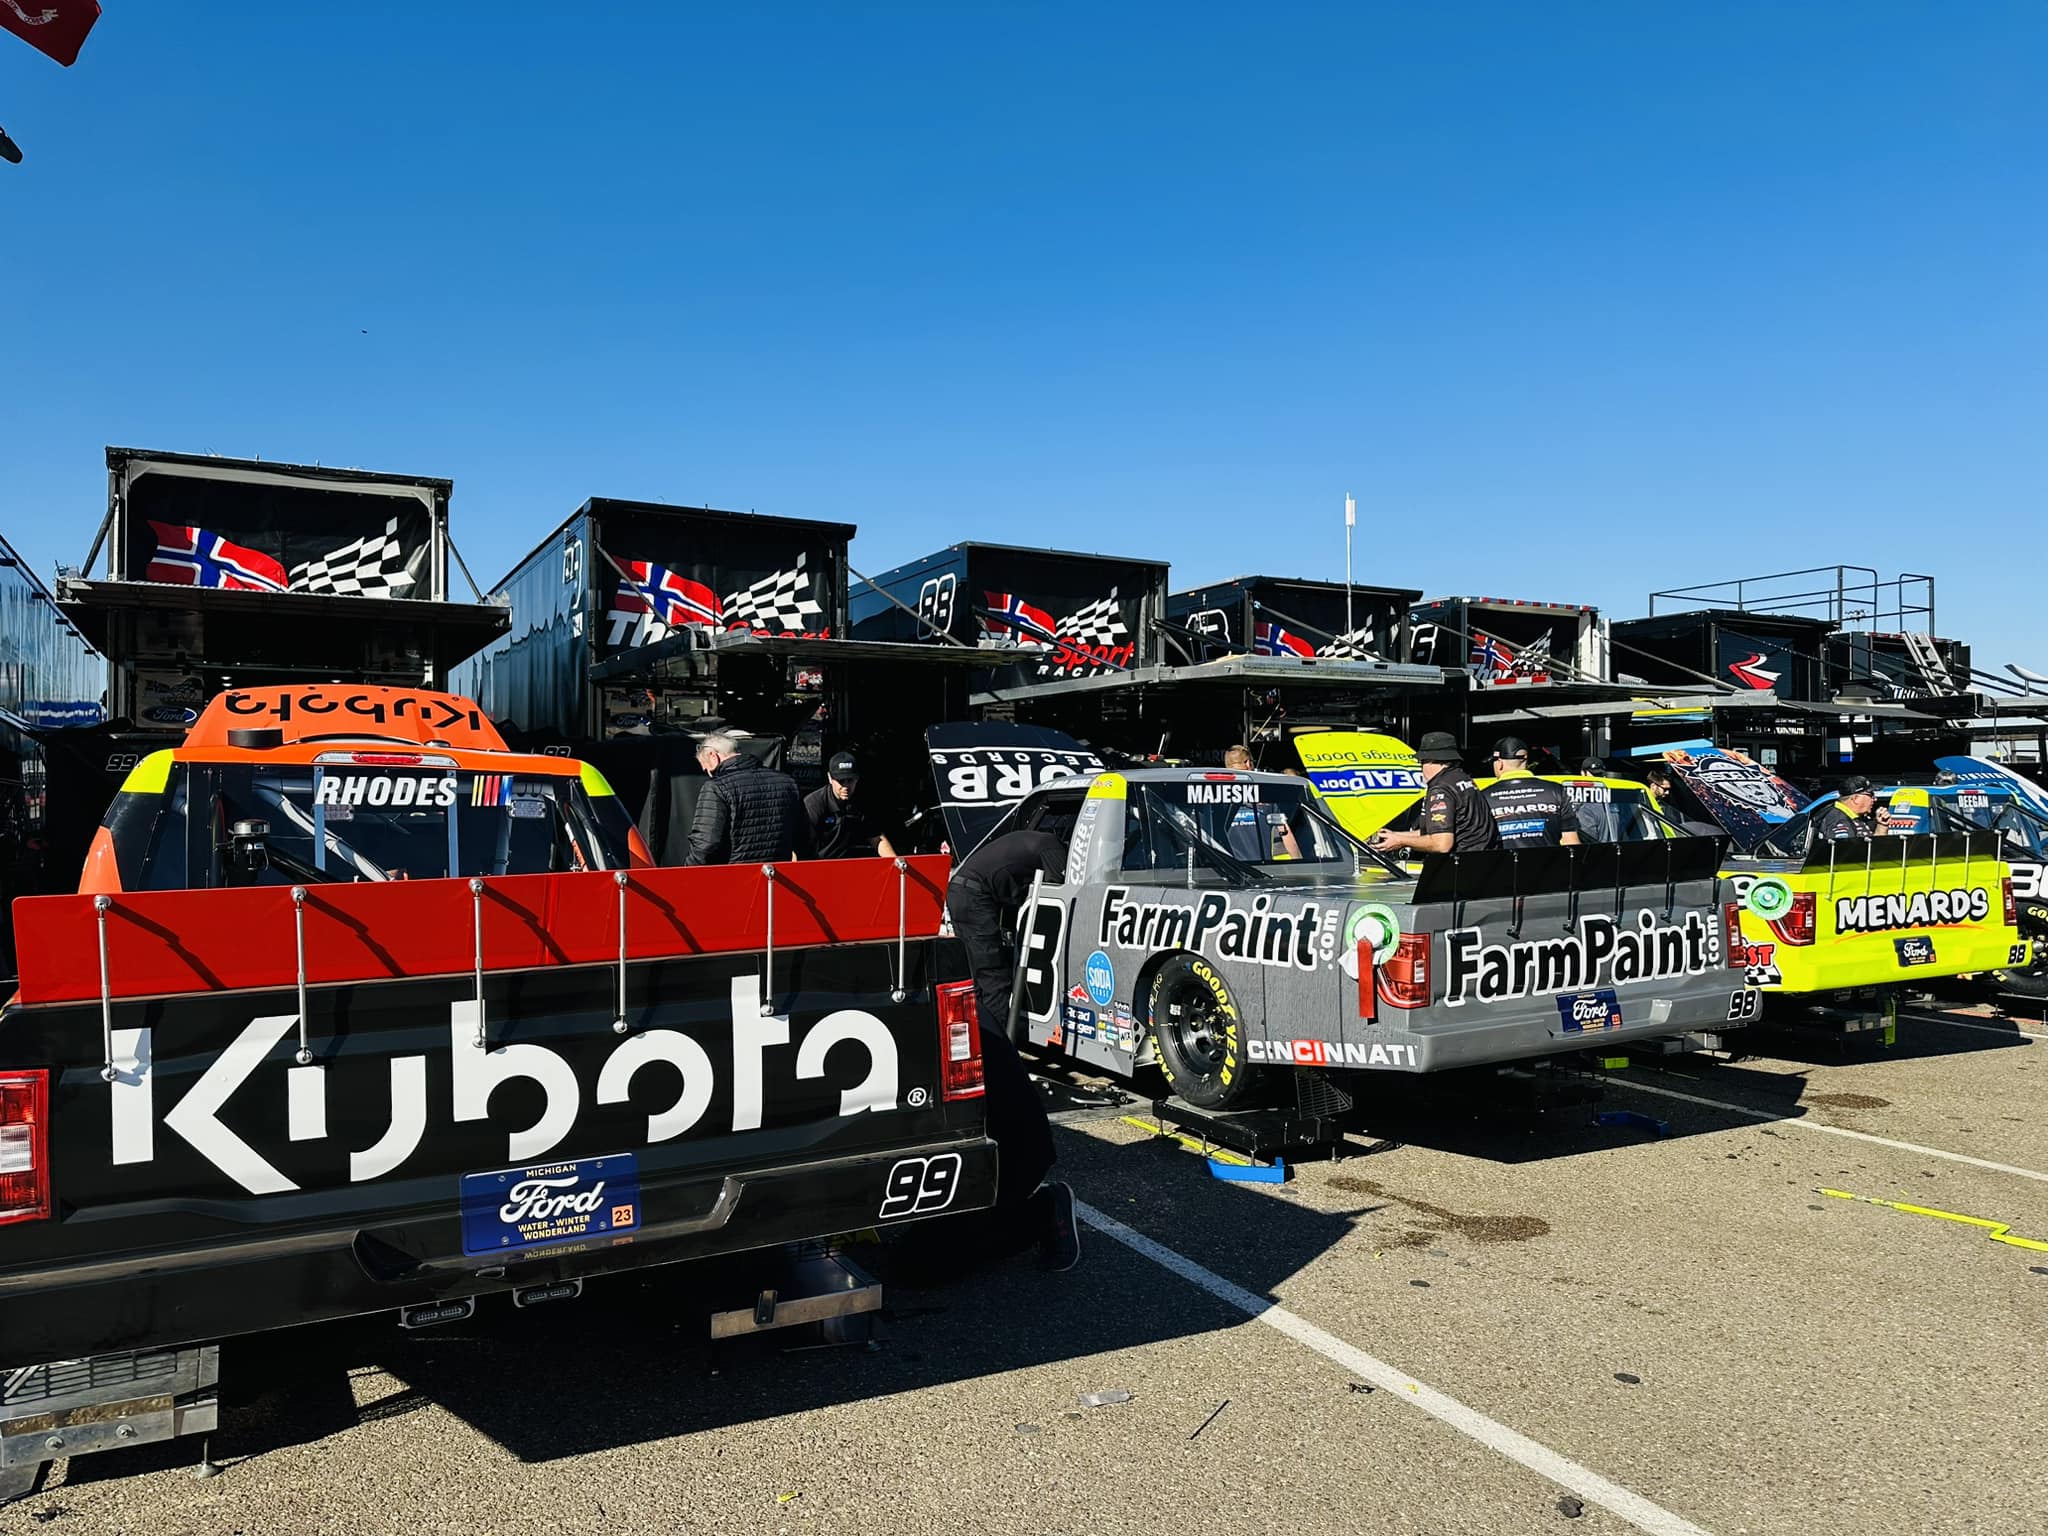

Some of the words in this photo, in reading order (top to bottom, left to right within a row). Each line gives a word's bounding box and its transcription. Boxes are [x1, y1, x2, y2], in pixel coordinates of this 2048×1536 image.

[225, 693, 481, 730] Kubota
[315, 776, 458, 807] RHODES
[1187, 784, 1260, 804] MAJESKI
[1565, 787, 1612, 803] RAFTON
[1835, 888, 1990, 934] MENARDS
[1573, 999, 1609, 1021] Ford
[1727, 989, 1758, 1021] 98
[1192, 961, 1238, 1086] GOODYEAR
[111, 974, 898, 1196] Kubota
[525, 1164, 577, 1178] MICHIGAN
[879, 1153, 962, 1219] 99
[500, 1175, 605, 1224] Ford
[614, 1208, 632, 1222] 23
[522, 1223, 586, 1241] WONDERLAND
